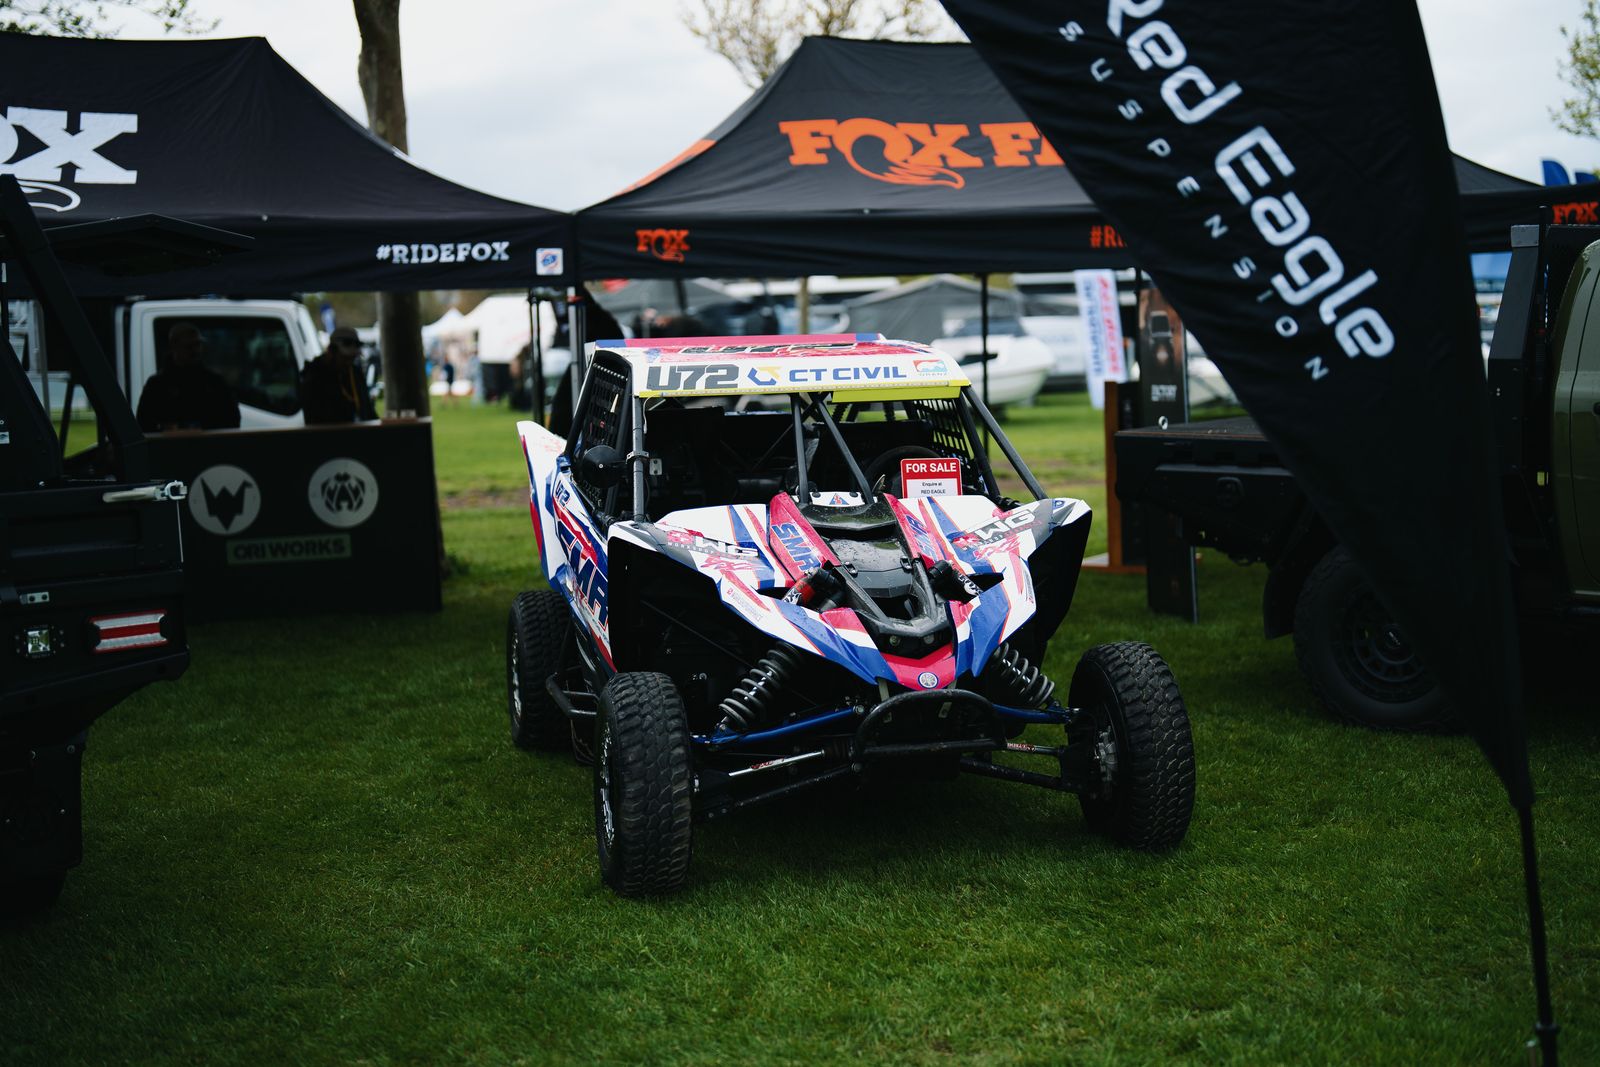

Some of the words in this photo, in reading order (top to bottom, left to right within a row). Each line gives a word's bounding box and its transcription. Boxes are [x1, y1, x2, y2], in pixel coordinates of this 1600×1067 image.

[778, 117, 984, 190] FOX
[1058, 20, 1330, 381] SUSPENSION
[376, 241, 510, 264] #RIDEFOX
[636, 229, 691, 263] FOX
[1214, 125, 1395, 358] Eagle
[646, 364, 740, 391] U72
[788, 368, 828, 382] CT
[832, 366, 907, 381] CIVIL
[905, 463, 927, 473] FOR
[929, 462, 957, 473] SALE
[974, 508, 1036, 542] WG
[234, 544, 267, 560] ORI
[268, 537, 346, 558] WORKS
[771, 522, 824, 572] SMR
